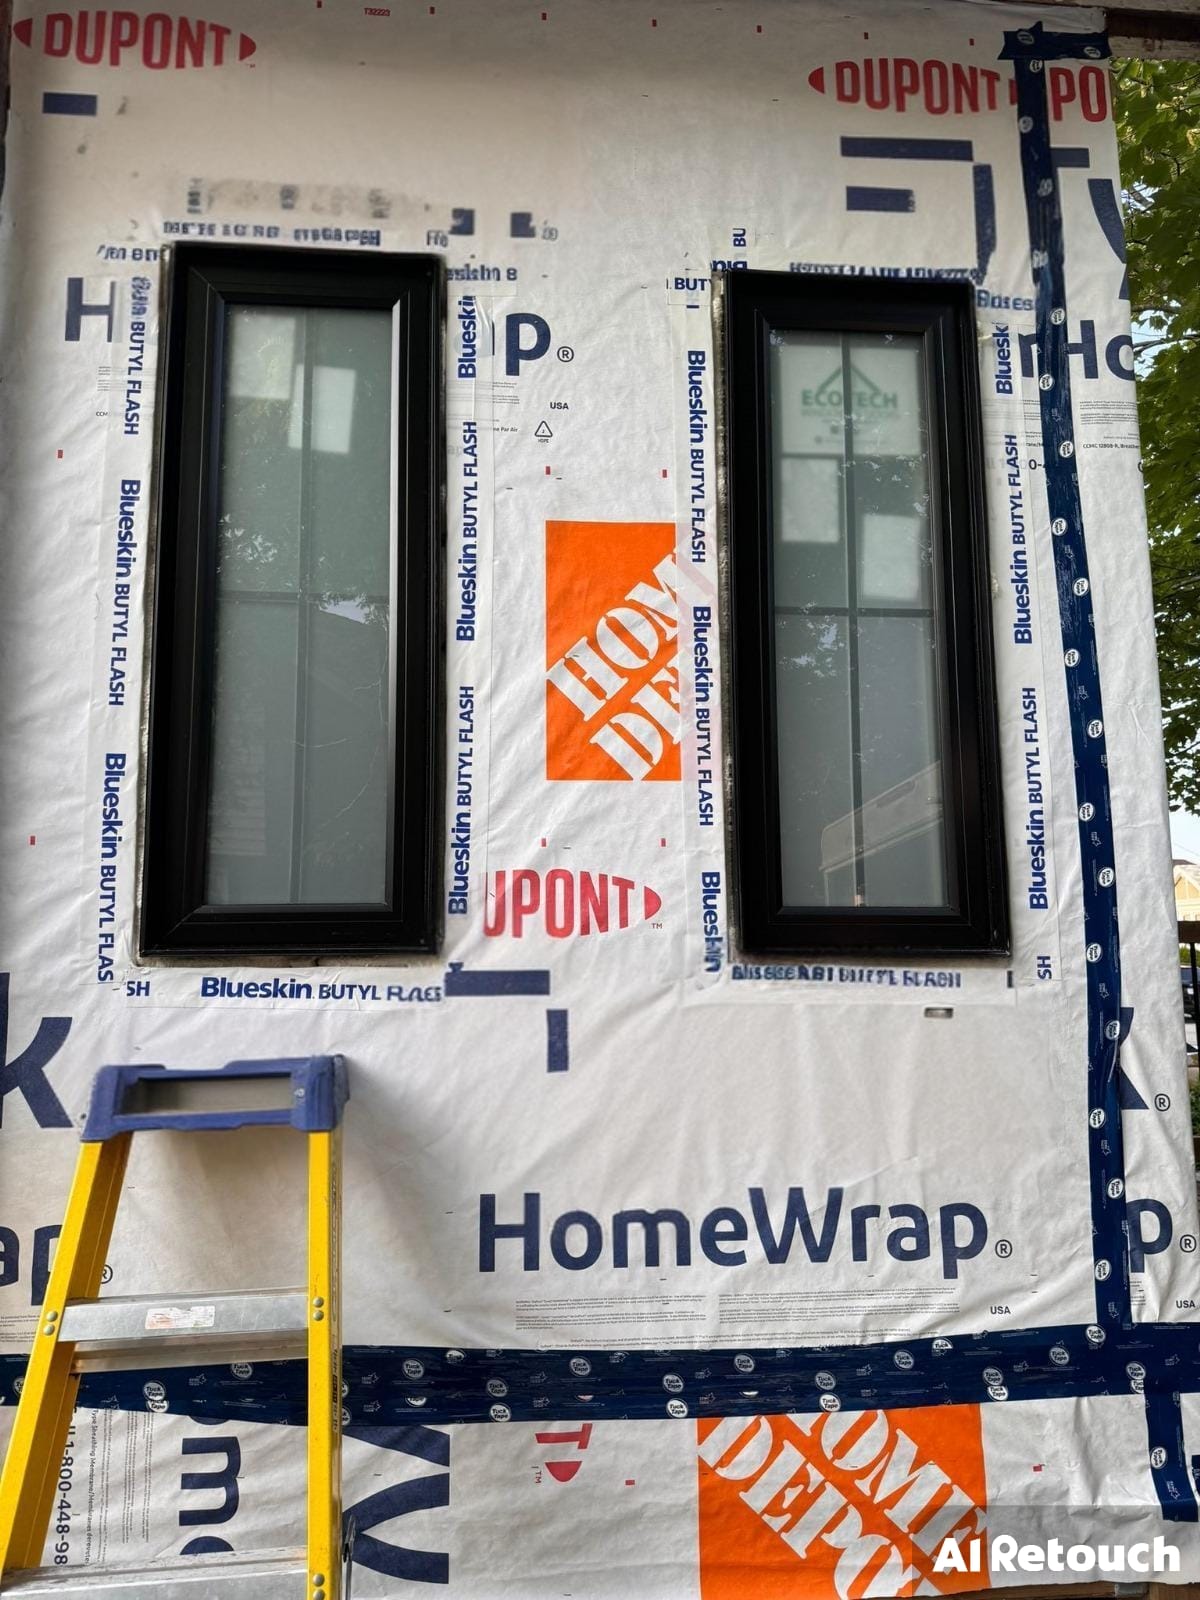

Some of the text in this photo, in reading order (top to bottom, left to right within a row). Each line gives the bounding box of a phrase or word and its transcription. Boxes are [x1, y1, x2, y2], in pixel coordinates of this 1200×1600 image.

[43, 11, 231, 70] DUPONT
[835, 58, 1000, 115] DUPONT
[128, 321, 145, 375] BUTYL
[124, 380, 142, 435] FLASH
[549, 401, 569, 410] USA
[801, 388, 898, 409] ECOECH
[688, 349, 706, 563] Blueskin BUTYL FLASH
[457, 421, 478, 641] Blueskin BUTYL FLASH
[1004, 434, 1033, 645] Blueskin BUTYL FLASH
[108, 479, 141, 706] Blueskin BUTYL FLASH
[547, 553, 680, 722] HOM
[692, 606, 714, 826] Blueskin BUTYL FLASH
[100, 753, 127, 859] Blueskin
[448, 686, 475, 915] Blueskin BUTYL FLASH
[1021, 687, 1049, 910] Blueskin BUTYL FLASH
[99, 864, 117, 928] BUTYL
[200, 976, 312, 1000] Blueskin
[318, 984, 382, 1001] BUTYL
[990, 1306, 1011, 1316] USA
[1175, 1300, 1196, 1310] USA
[89, 1425, 98, 1457] Sheathing
